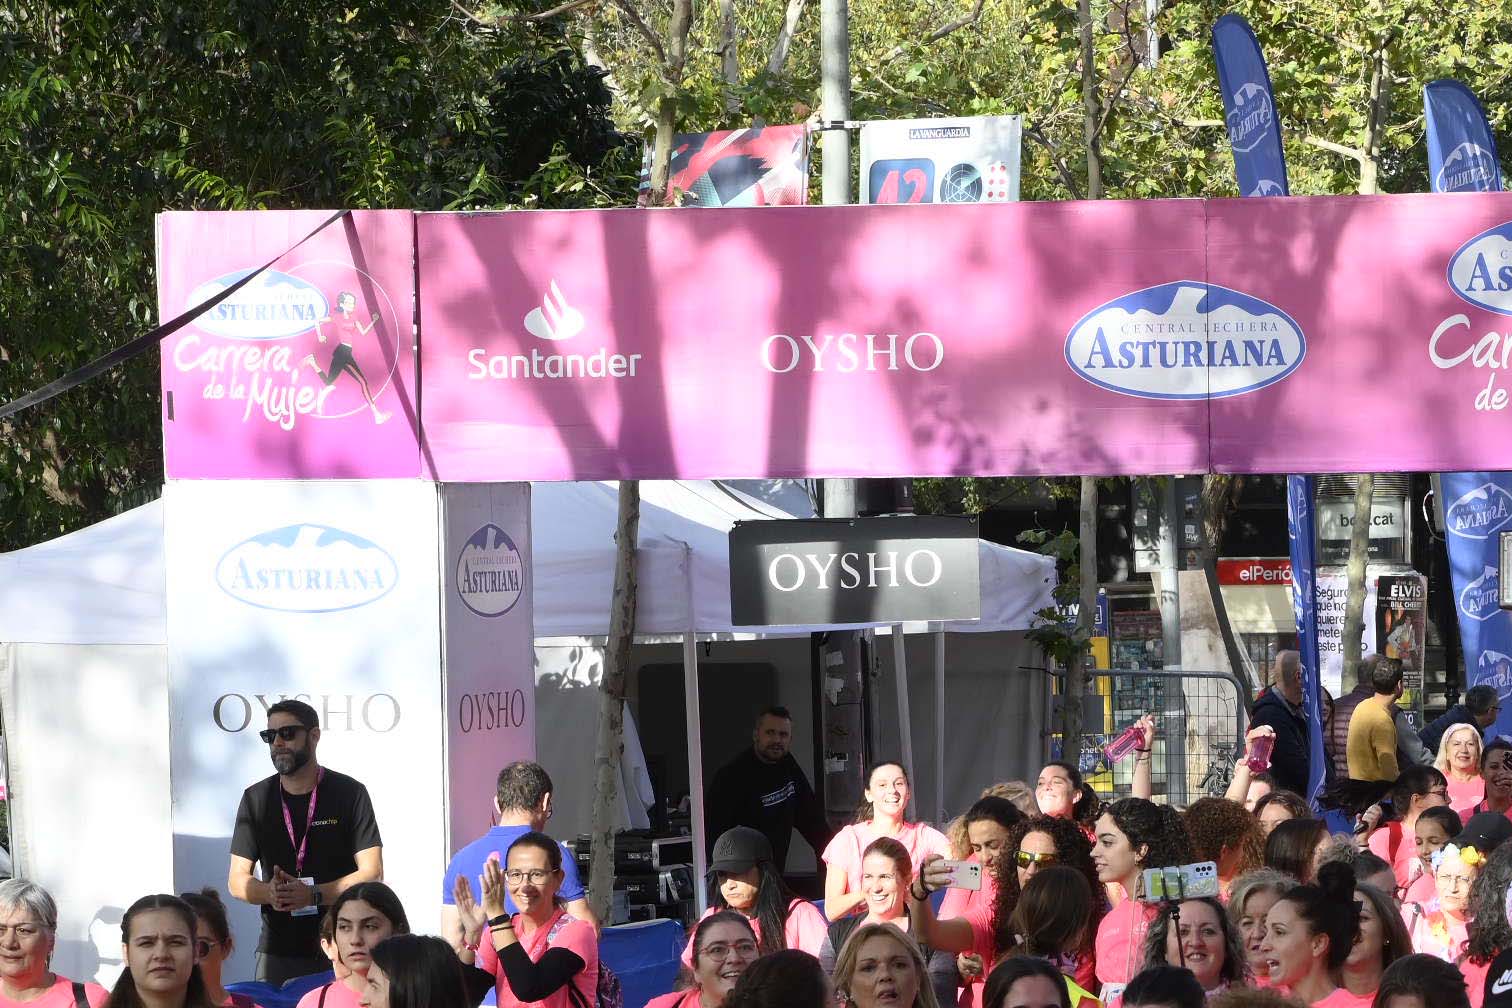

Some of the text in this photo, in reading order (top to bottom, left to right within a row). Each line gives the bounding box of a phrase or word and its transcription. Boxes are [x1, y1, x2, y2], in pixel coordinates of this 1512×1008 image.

[920, 127, 970, 139] VANGUARDIA
[208, 303, 318, 322] STURIANA
[1120, 320, 1280, 335] CENTRAL LECHERA
[173, 335, 291, 372] Carrera
[468, 347, 642, 379] Santander
[760, 332, 944, 373] OYSHO
[1085, 327, 1288, 370] ASTURIANA
[203, 370, 336, 431] de la Mujer
[1474, 374, 1509, 411] de
[231, 556, 386, 591] ASTURIANA
[462, 559, 520, 594] ASTURIANA
[769, 550, 943, 593] OYSHO
[1391, 584, 1421, 597] ELVIS
[460, 688, 526, 733] OYSHO
